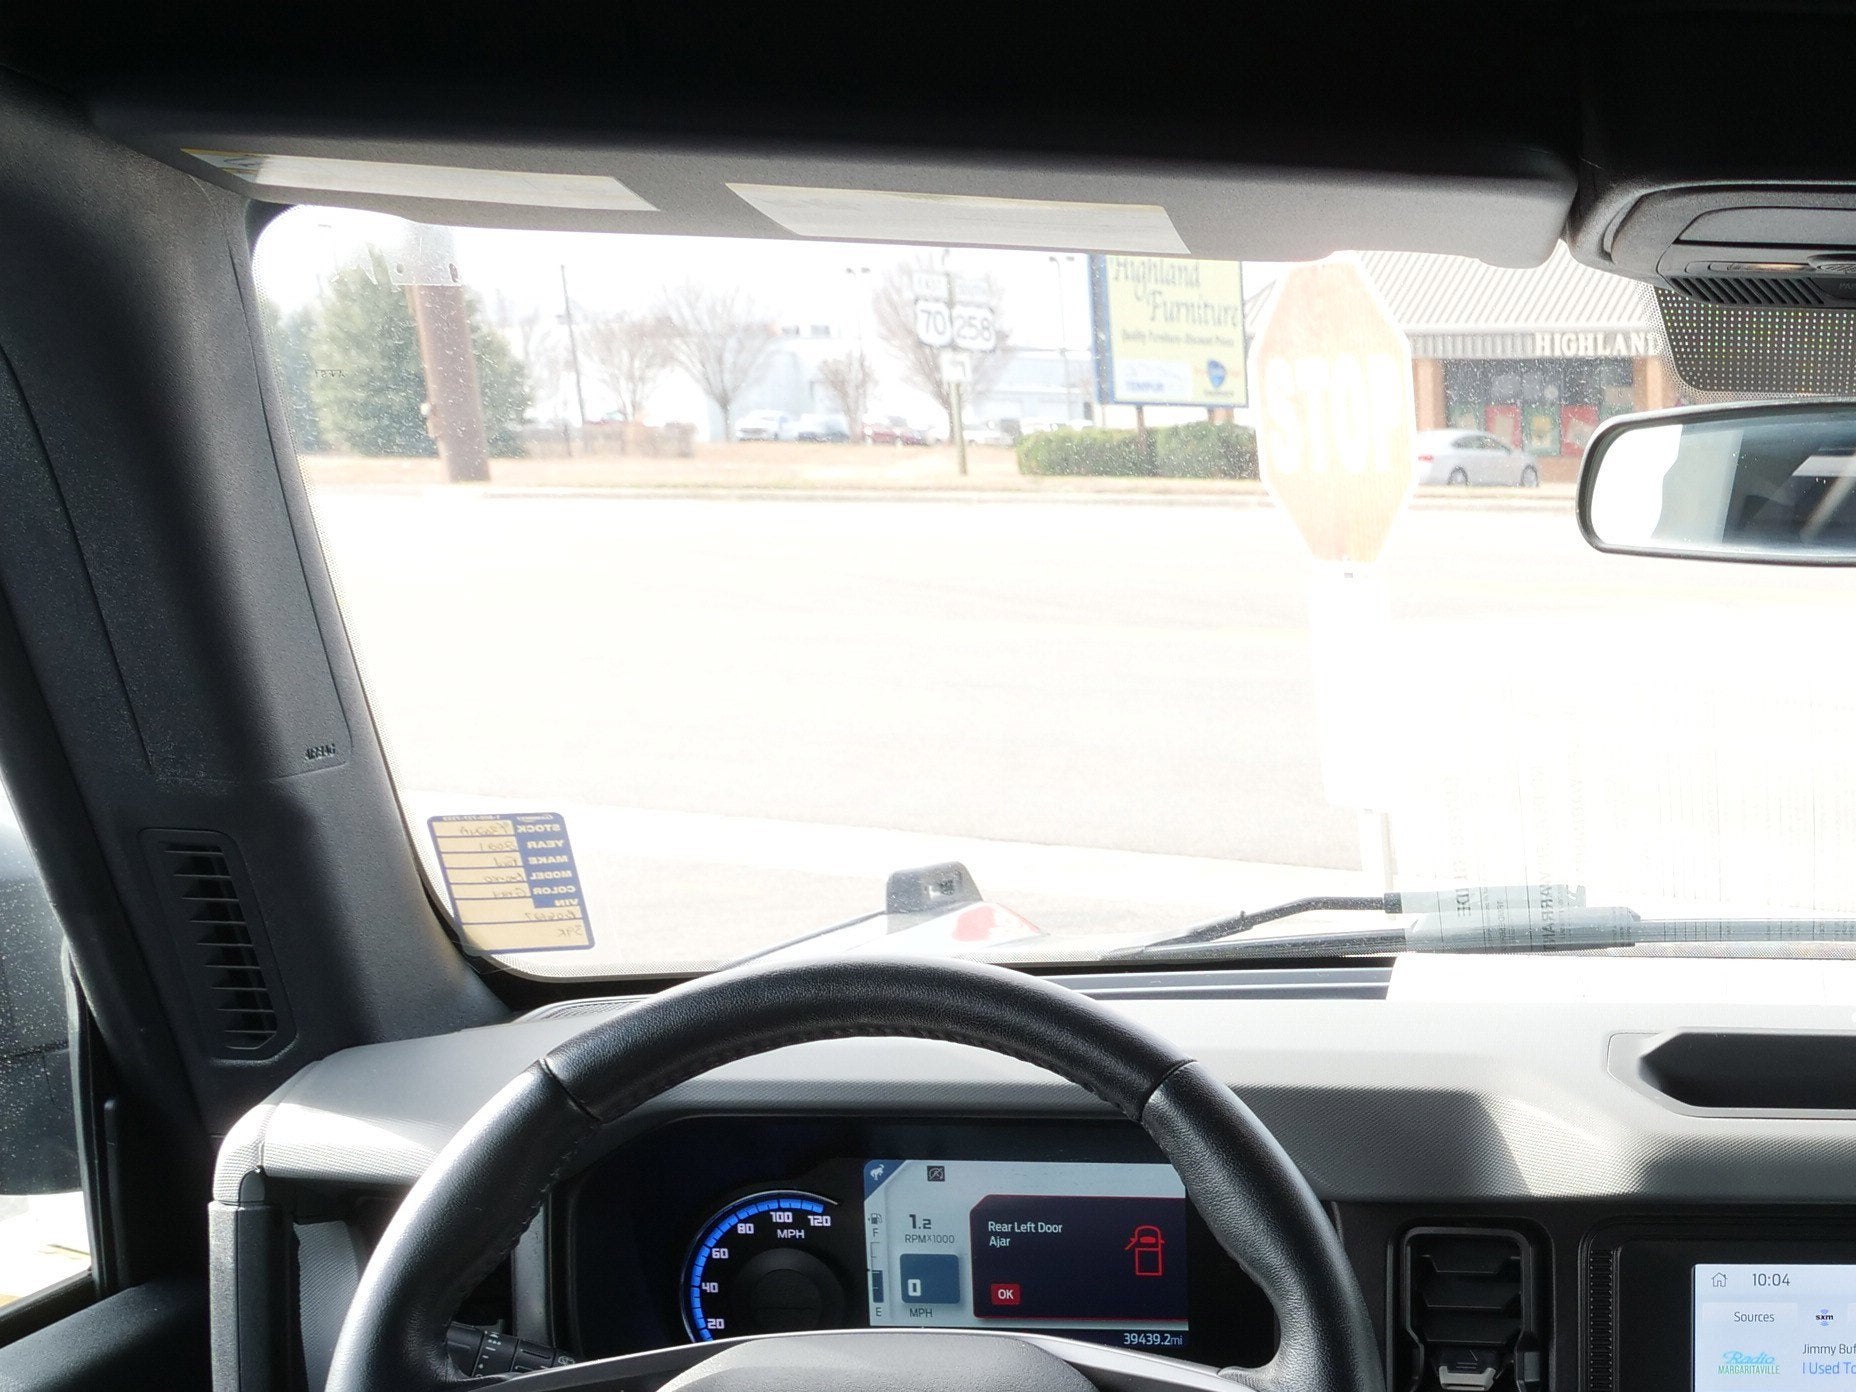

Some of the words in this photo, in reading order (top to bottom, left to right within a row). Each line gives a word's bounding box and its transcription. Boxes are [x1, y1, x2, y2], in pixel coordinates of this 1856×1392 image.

[1147, 288, 1243, 328] Furniture
[919, 309, 947, 336] 70
[956, 316, 991, 342] 258
[1268, 357, 1399, 474] STOP
[769, 1211, 794, 1224] 100
[807, 1215, 831, 1227] 120
[908, 1214, 932, 1230] 1.2
[736, 1222, 755, 1235] 80
[872, 1228, 879, 1238] F
[987, 1220, 1011, 1234] Rear
[1013, 1220, 1036, 1234] Left
[1038, 1221, 1063, 1234] Door
[776, 1229, 806, 1240] MPH
[988, 1235, 1011, 1250] Ajar
[711, 1247, 729, 1260] 60
[1751, 1273, 1791, 1287] 10:04
[702, 1282, 719, 1294] 40
[907, 1278, 922, 1297] 0
[997, 1289, 1014, 1300] OK
[875, 1308, 882, 1317] E
[909, 1308, 933, 1318] MPH
[1733, 1311, 1775, 1324] Sources
[707, 1317, 725, 1330] 20
[1802, 1343, 1836, 1356] Jimmy
[1722, 1350, 1776, 1366] Radio
[1718, 1364, 1780, 1376] MARGARITAVILLE
[1802, 1362, 1806, 1375] I
[1809, 1361, 1840, 1376] Used
